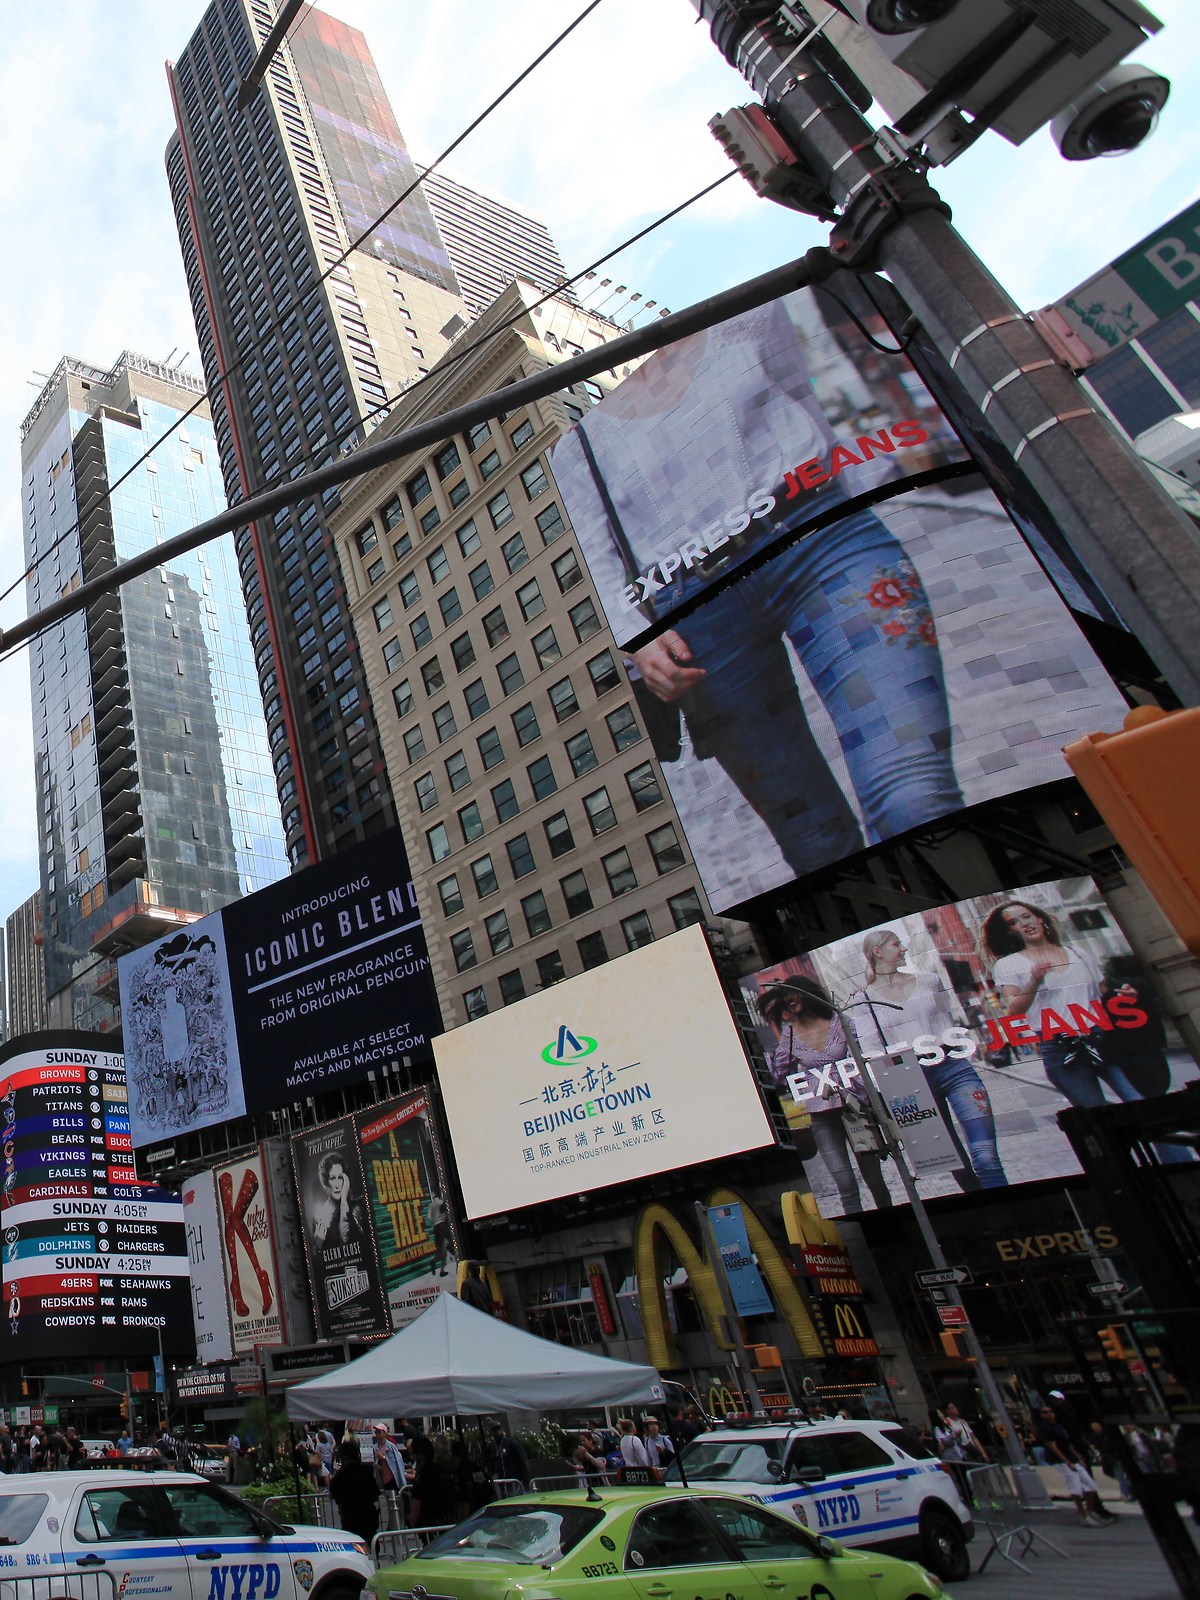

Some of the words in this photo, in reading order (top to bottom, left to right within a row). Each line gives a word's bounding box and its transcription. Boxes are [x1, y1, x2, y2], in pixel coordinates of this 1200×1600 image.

[617, 486, 777, 613] EXPRESS
[782, 420, 929, 499] JEANS
[282, 876, 371, 923] INTRODUCING
[245, 921, 325, 976] ICONIC
[337, 881, 420, 937] BLEND
[269, 992, 295, 1009] THE
[296, 979, 326, 1002] NEW
[330, 944, 414, 987] FRAGRANCE
[260, 1008, 296, 1029] FROM
[299, 984, 363, 1015] ORIGINAL
[367, 955, 430, 991] PENGUIN
[293, 1044, 350, 1071] AVAILABLE
[352, 1039, 366, 1052] AT
[369, 1023, 412, 1047] SELECT
[786, 1026, 977, 1102] EXPSS
[986, 995, 1149, 1051] JEANS
[46, 1053, 97, 1064] SUNDAY
[104, 1056, 125, 1067] 1:00
[286, 1067, 325, 1087] MACY'S
[327, 1058, 351, 1076] AND
[353, 1034, 425, 1069] MACYS.COM
[40, 1070, 81, 1079] BROWNS
[105, 1073, 127, 1082] RAVE
[32, 1086, 81, 1096] PATRIOTS
[45, 1102, 83, 1111] TITANS
[889, 1095, 918, 1108] DEAR
[523, 1082, 652, 1136] BEIJINGETOWN
[892, 1103, 919, 1116] EVAN
[52, 1118, 84, 1127] BILLS
[896, 1108, 937, 1126] HANSEN
[51, 1135, 84, 1144] BEARS
[90, 1136, 104, 1145] FOX
[523, 1109, 665, 1162] 国际高端产业新区
[307, 1134, 345, 1157] TRIUMPH!
[388, 1130, 399, 1158] A
[40, 1152, 86, 1161] VIKINGS
[91, 1152, 105, 1161] FOX
[111, 1154, 133, 1163] STEE
[530, 1155, 576, 1173] TOP-RANKED
[577, 1143, 621, 1160] INDUSTRIAL
[622, 1136, 641, 1148] NEW
[643, 1129, 666, 1141] ZONE
[48, 1169, 87, 1178] EAGLES
[92, 1169, 106, 1178] FOX
[112, 1171, 135, 1180] CHIE
[372, 1158, 425, 1205] BRONX
[29, 1186, 87, 1197] CARDINALS
[93, 1186, 107, 1195] FOX
[113, 1188, 142, 1198] COLTS
[52, 1203, 108, 1215] SUNDAY
[114, 1205, 138, 1217] 4:05
[64, 1222, 90, 1232] JETS
[116, 1224, 157, 1234] RAIDERS
[387, 1200, 430, 1249] TALE
[38, 1241, 91, 1251] DOLPHINS
[117, 1242, 165, 1252] CHARGERS
[323, 1247, 342, 1262] GLENN
[342, 1241, 361, 1258] CLOSE
[722, 1251, 741, 1261] EVAN
[805, 1254, 850, 1265] McDonald's
[55, 1257, 111, 1269] SUNDAY
[117, 1259, 142, 1271] 4:25
[725, 1257, 752, 1270] HANSEN
[60, 1278, 93, 1288] 49ERS
[100, 1279, 114, 1287] FOX
[120, 1280, 171, 1289] SEAHAWKS
[923, 1273, 938, 1283] ONE
[939, 1272, 955, 1281] WAY
[330, 1275, 358, 1304] SUNSET
[41, 1297, 95, 1308] REDSKINS
[100, 1297, 115, 1306] FOX
[121, 1298, 147, 1307] RAMS
[390, 1302, 406, 1310] JERSEY
[406, 1299, 418, 1307] BOYS
[45, 1315, 96, 1326] COWBOYS
[102, 1316, 116, 1325] FOX
[122, 1316, 166, 1326] BRONCOS
[194, 1374, 209, 1385] CENTER
[217, 1373, 226, 1382] THE
[626, 1471, 649, 1483] BB723
[815, 1494, 860, 1527] NYPD
[26, 1553, 41, 1566] SRG
[43, 1553, 48, 1564] 4
[581, 1561, 619, 1578] BB723
[123, 1572, 155, 1583] COURTESY
[208, 1563, 281, 1600] NYPD
[119, 1584, 173, 1596] PROFESSIONALISM
